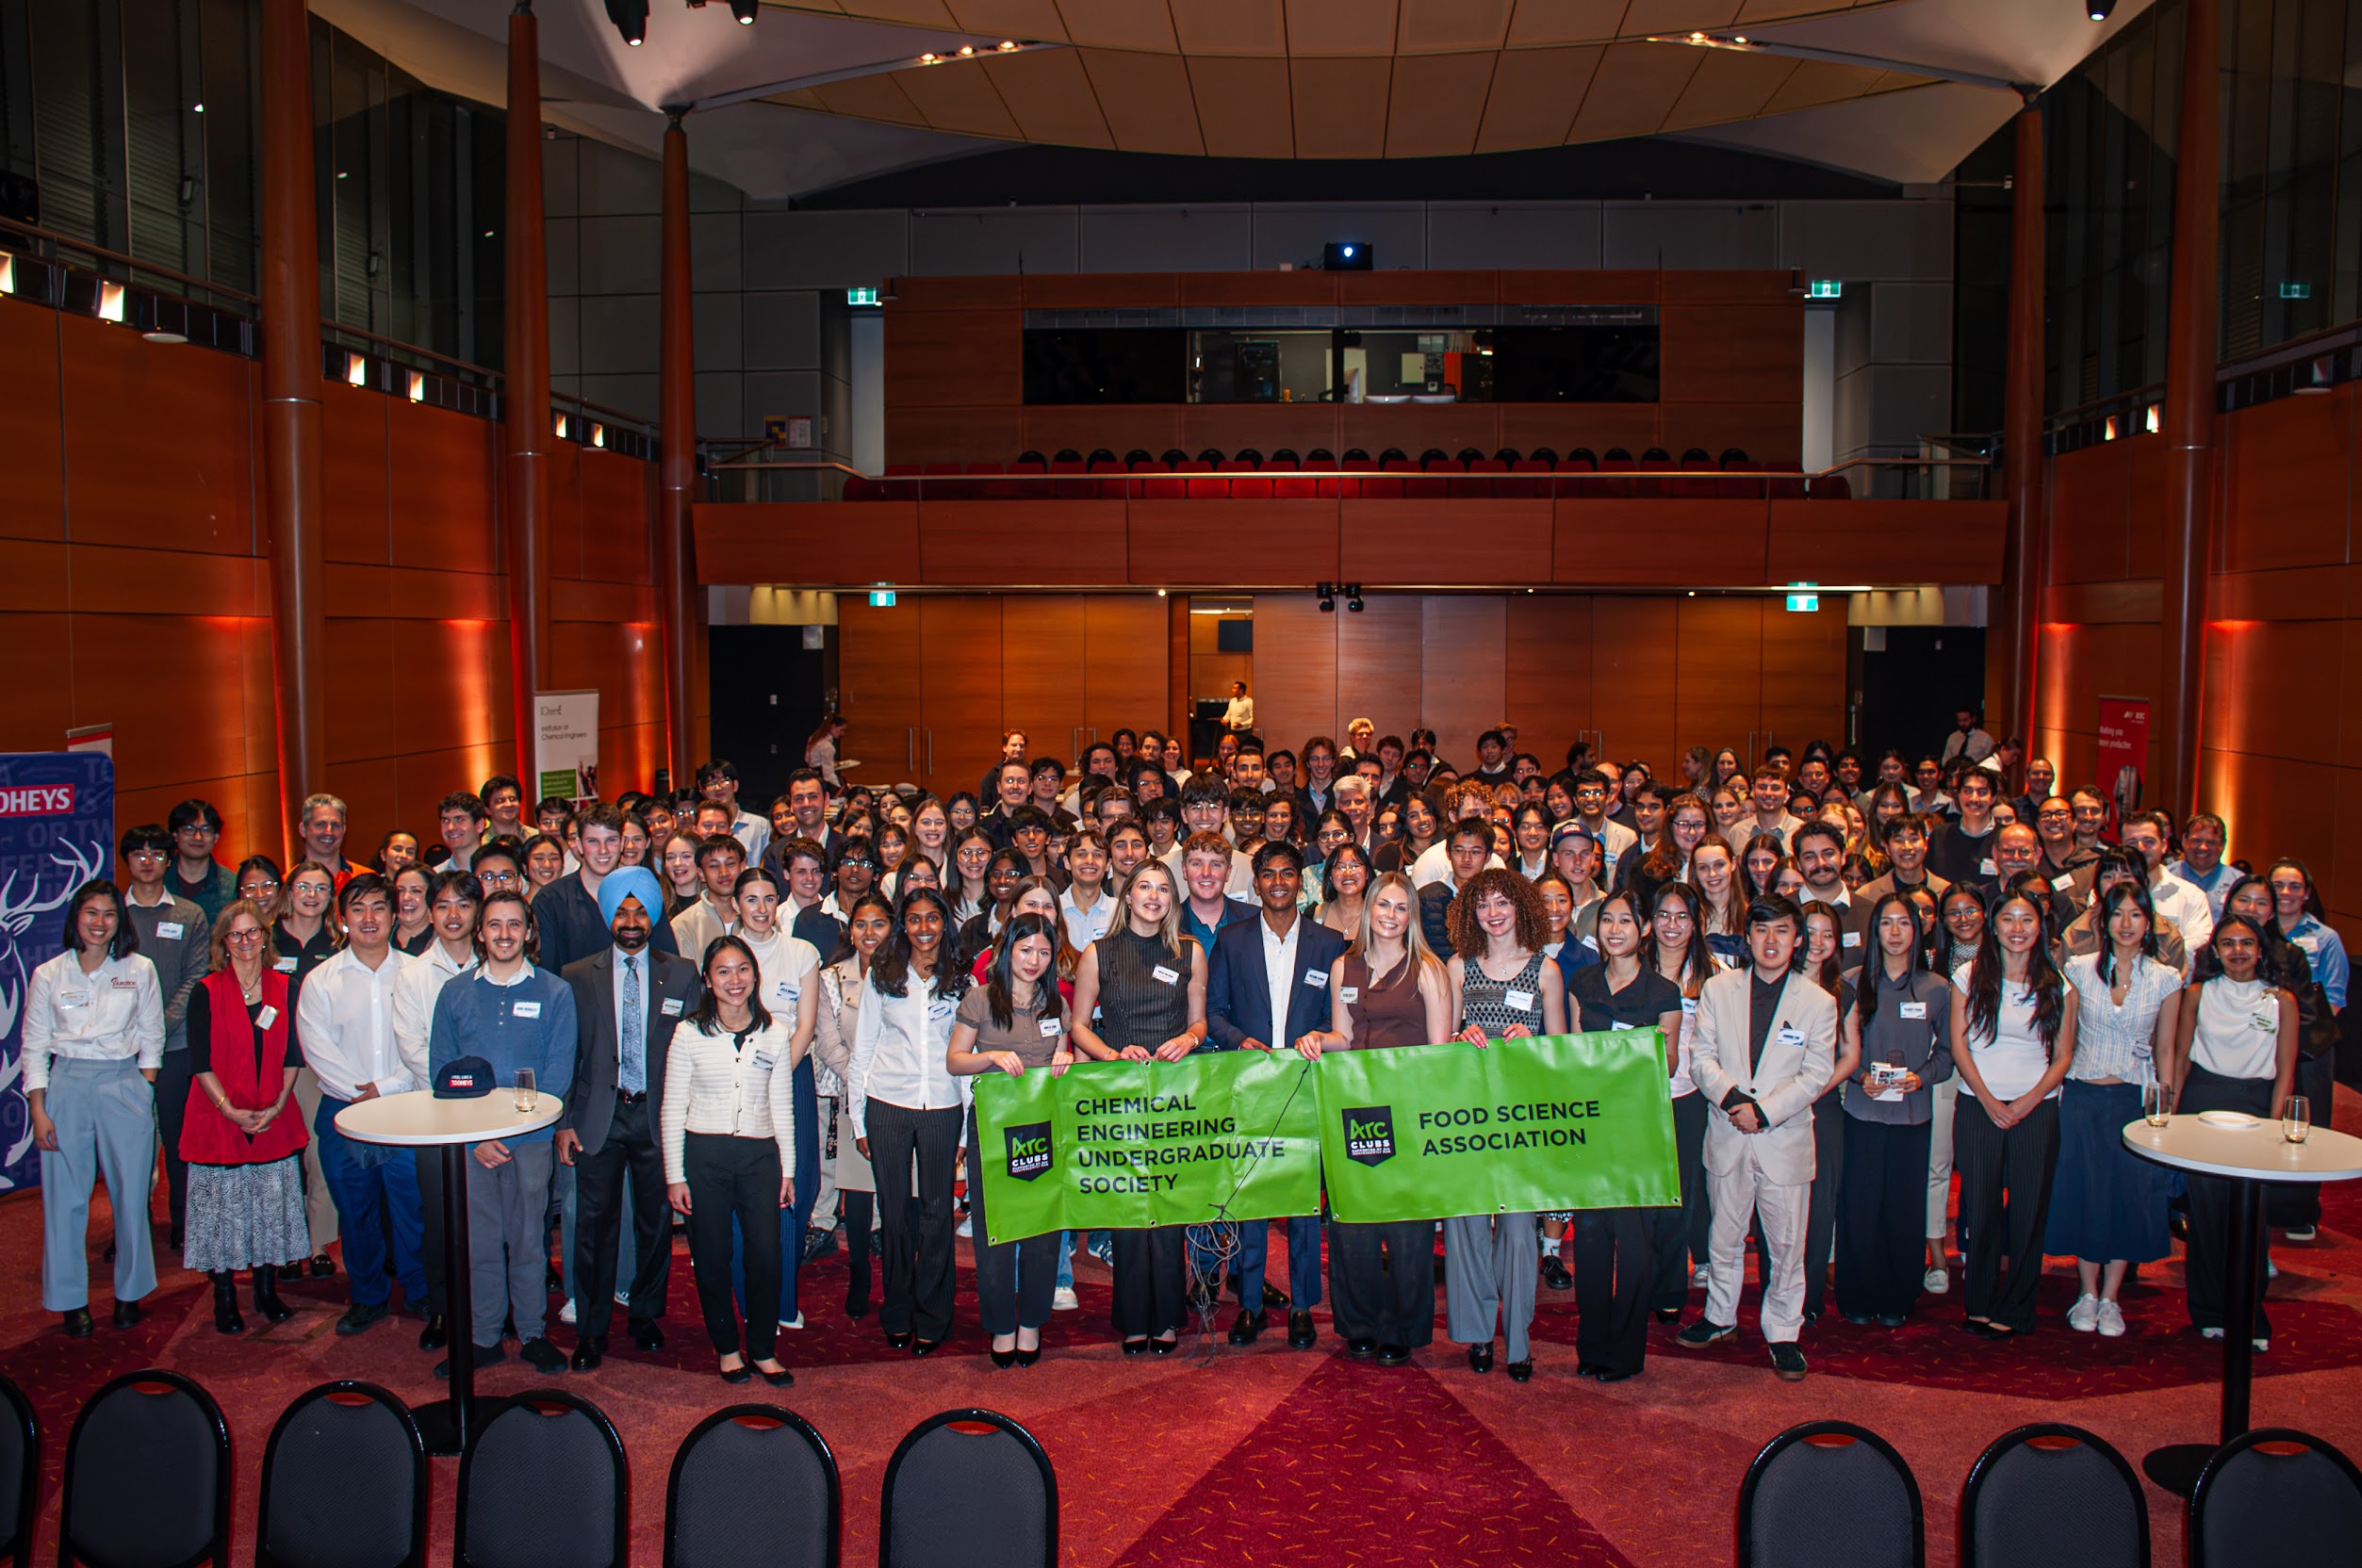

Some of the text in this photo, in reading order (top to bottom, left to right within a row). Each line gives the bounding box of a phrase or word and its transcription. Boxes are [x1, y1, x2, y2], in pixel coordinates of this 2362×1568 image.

[1075, 1095, 1196, 1116] CHEMICAL
[1419, 1101, 1600, 1129] FOOD SCIENCE
[1077, 1117, 1235, 1141] ENGINEERING
[1351, 1139, 1390, 1150] CLUBS
[1422, 1128, 1586, 1156] ASSOCIATION
[1011, 1152, 1048, 1168] CLUBS
[1078, 1141, 1285, 1167] UNDERGRADUATE
[1079, 1173, 1178, 1194] SOCIETY
